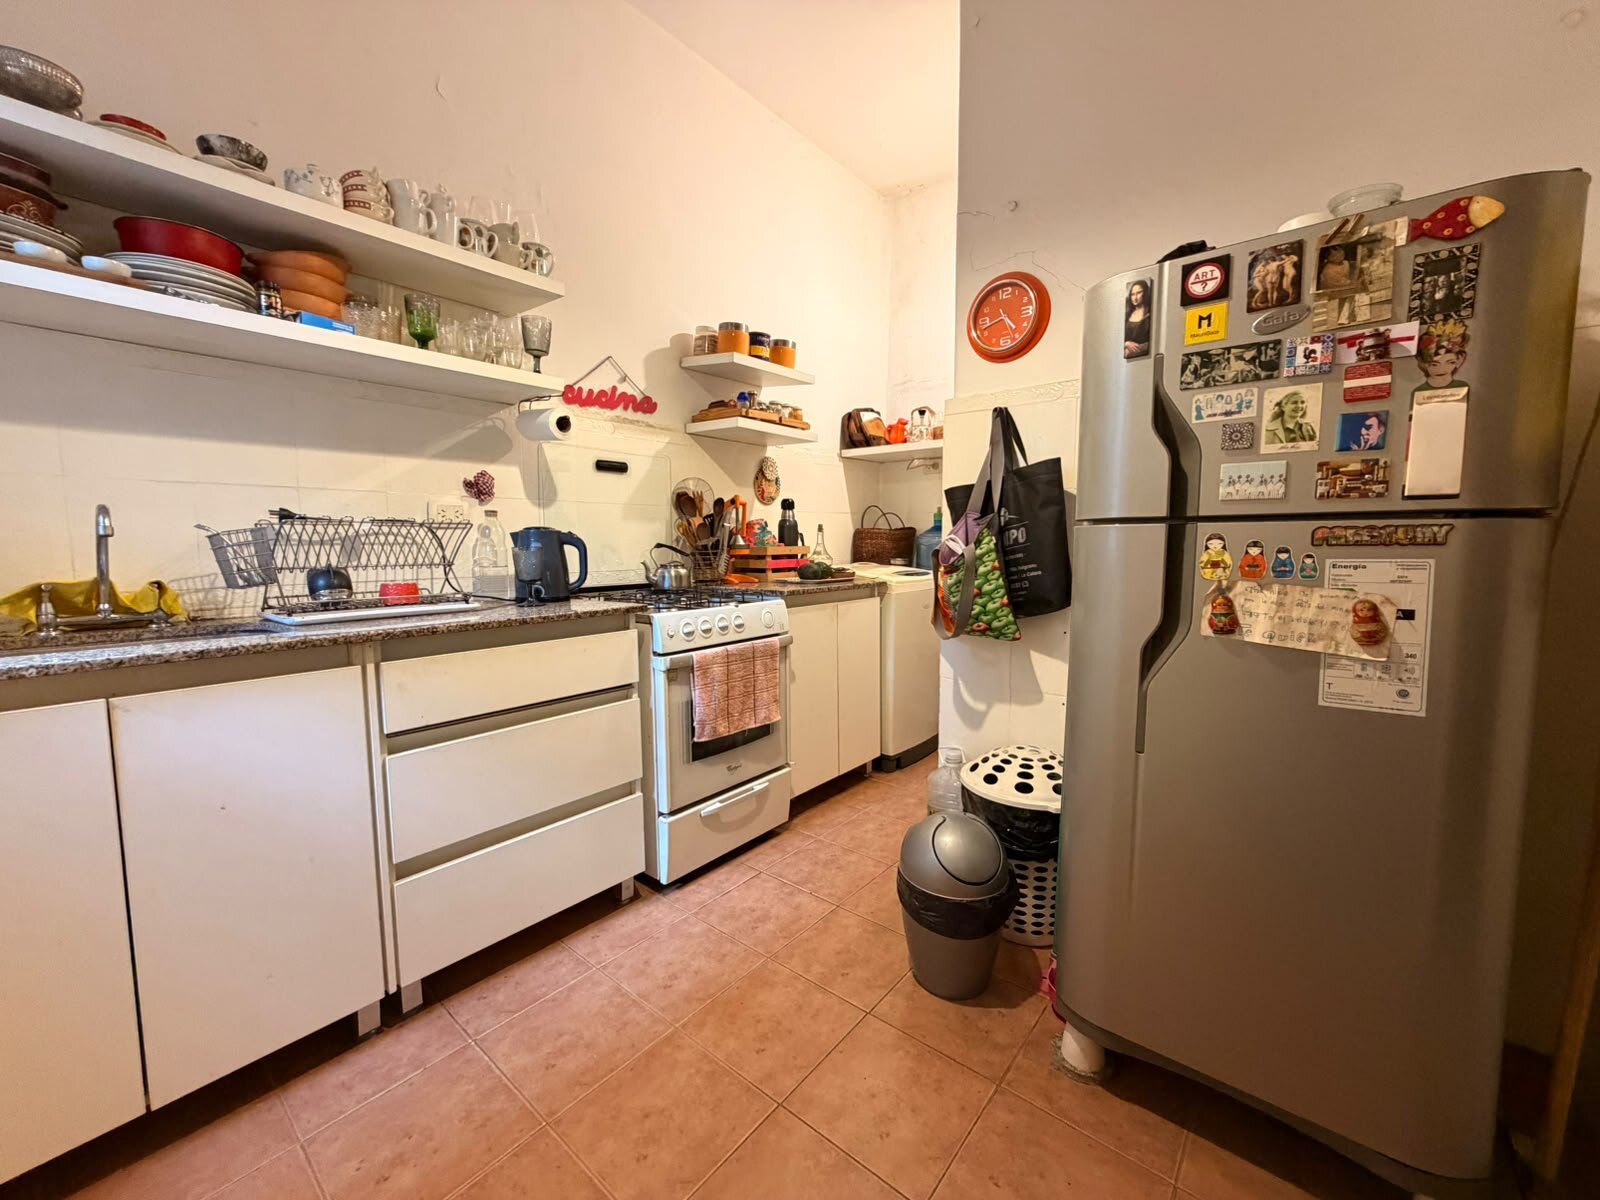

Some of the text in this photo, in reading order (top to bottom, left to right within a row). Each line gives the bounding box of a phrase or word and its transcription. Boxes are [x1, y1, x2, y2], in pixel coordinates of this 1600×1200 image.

[1193, 269, 1216, 281] ART
[998, 286, 1013, 300] 12
[1020, 305, 1033, 318] 3
[1197, 312, 1213, 330] M
[1000, 335, 1011, 346] 6
